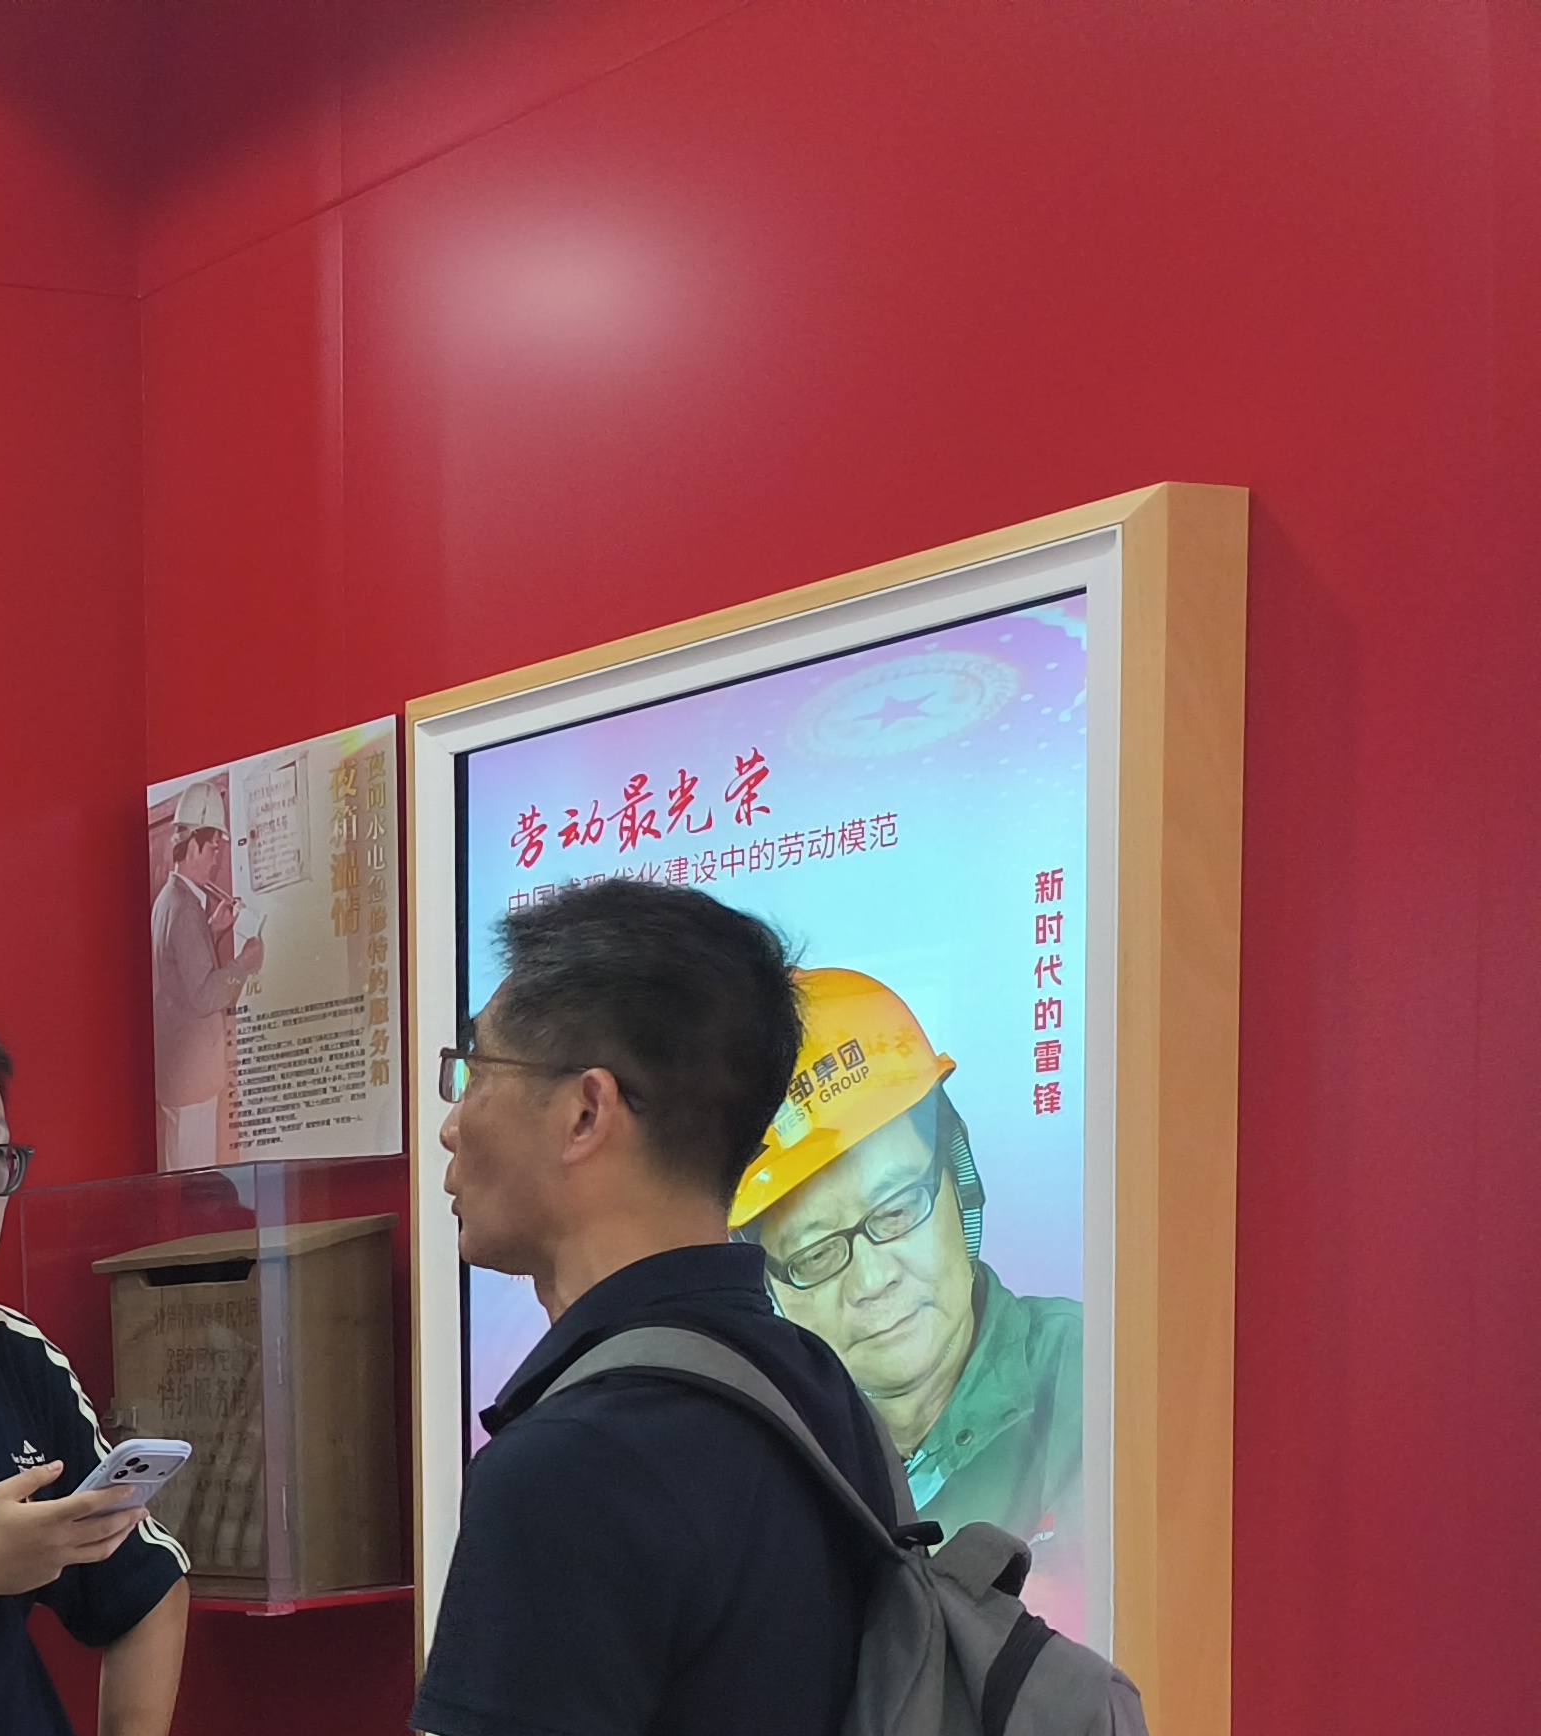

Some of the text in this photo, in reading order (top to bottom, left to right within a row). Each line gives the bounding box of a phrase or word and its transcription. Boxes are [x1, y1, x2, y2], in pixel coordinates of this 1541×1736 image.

[510, 747, 771, 869] 劳动最光荣
[1032, 867, 1064, 1115] 新时代的雷锋
[818, 1065, 870, 1104] GROUP
